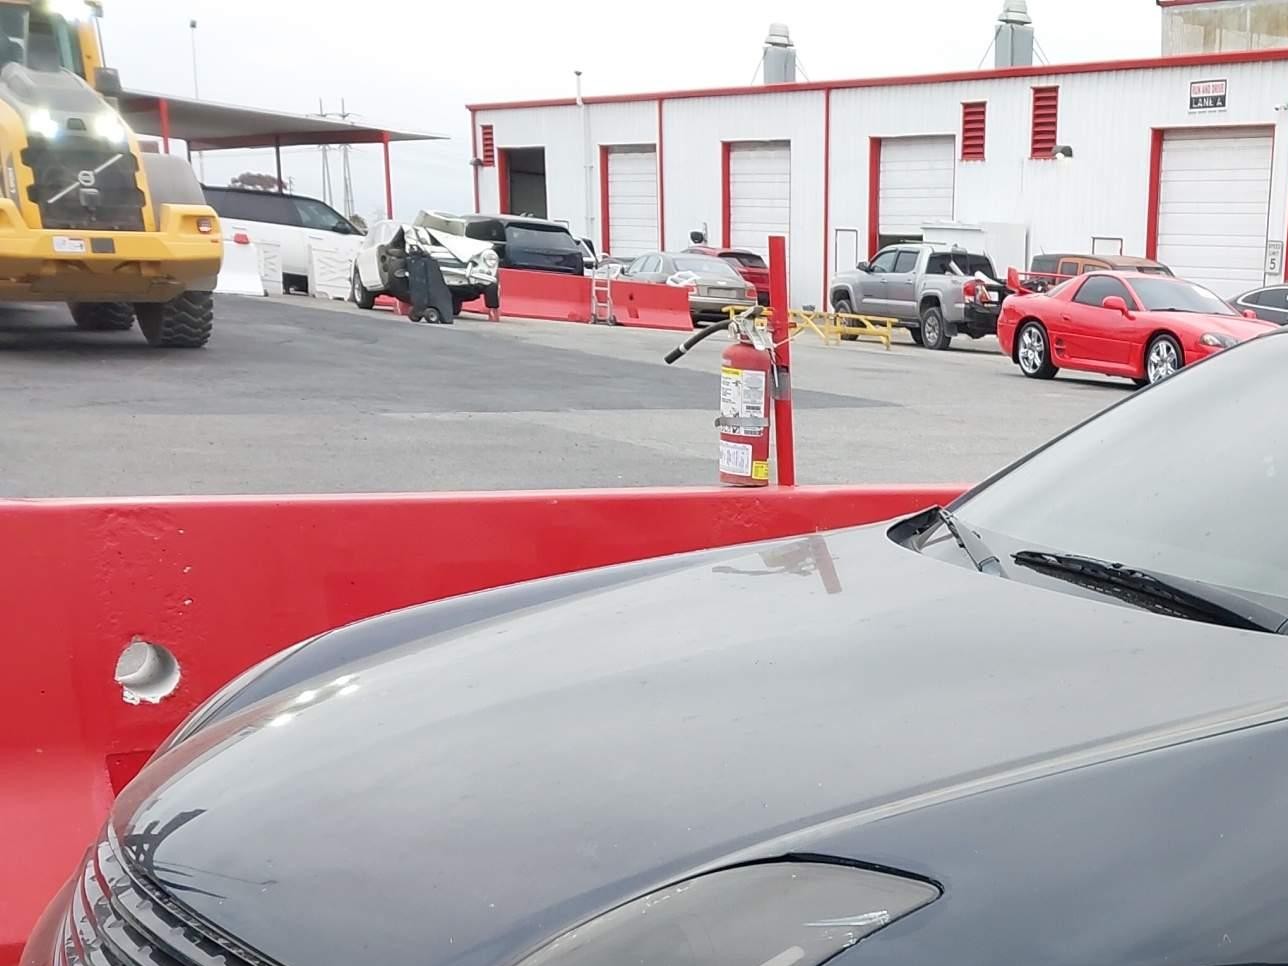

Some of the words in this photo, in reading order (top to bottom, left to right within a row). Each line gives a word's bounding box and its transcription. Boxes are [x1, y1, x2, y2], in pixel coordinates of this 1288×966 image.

[1192, 97, 1214, 108] LANE
[1216, 96, 1223, 106] A
[1269, 257, 1276, 270] 5
